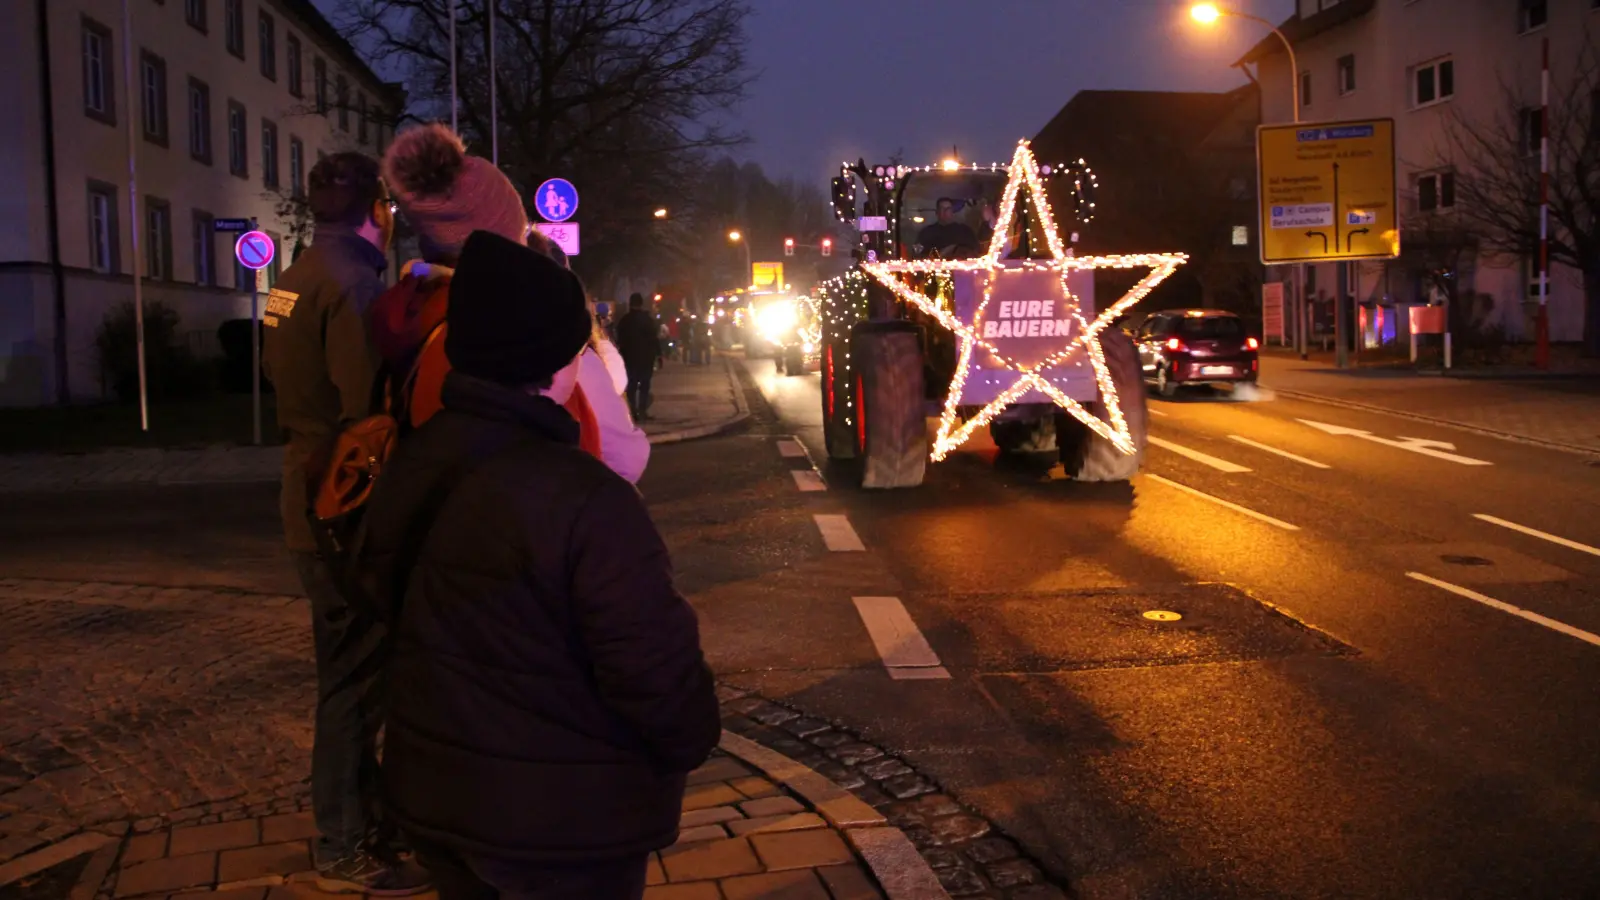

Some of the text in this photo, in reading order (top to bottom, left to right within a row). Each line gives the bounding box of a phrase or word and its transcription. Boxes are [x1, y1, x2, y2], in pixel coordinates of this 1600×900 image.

[1298, 205, 1331, 214] Campus
[1272, 217, 1324, 226] Berufsschule
[999, 300, 1055, 318] EURE
[983, 319, 1071, 338] BAUERN
